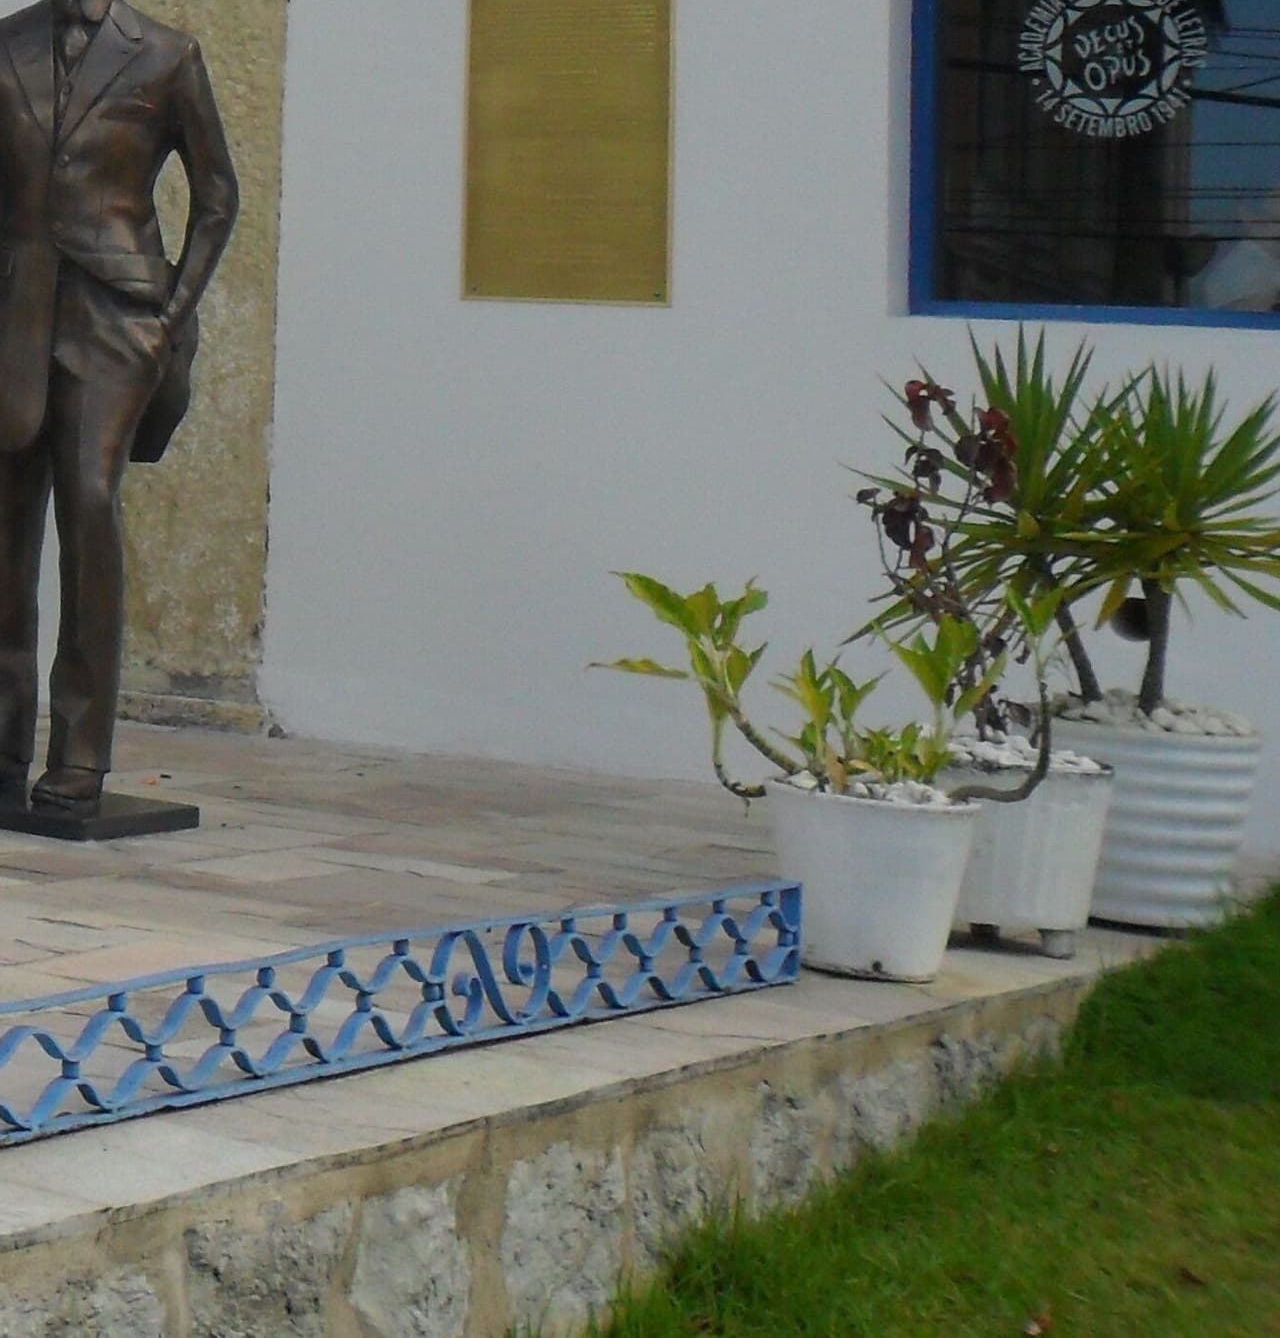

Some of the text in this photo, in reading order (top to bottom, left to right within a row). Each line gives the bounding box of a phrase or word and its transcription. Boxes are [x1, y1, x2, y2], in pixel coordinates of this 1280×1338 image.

[1072, 15, 1145, 58] DECUS
[1175, 8, 1208, 68] LETRAS
[1083, 50, 1151, 91] OPUS
[1035, 87, 1192, 138] 14 SETEMBRO 1941
